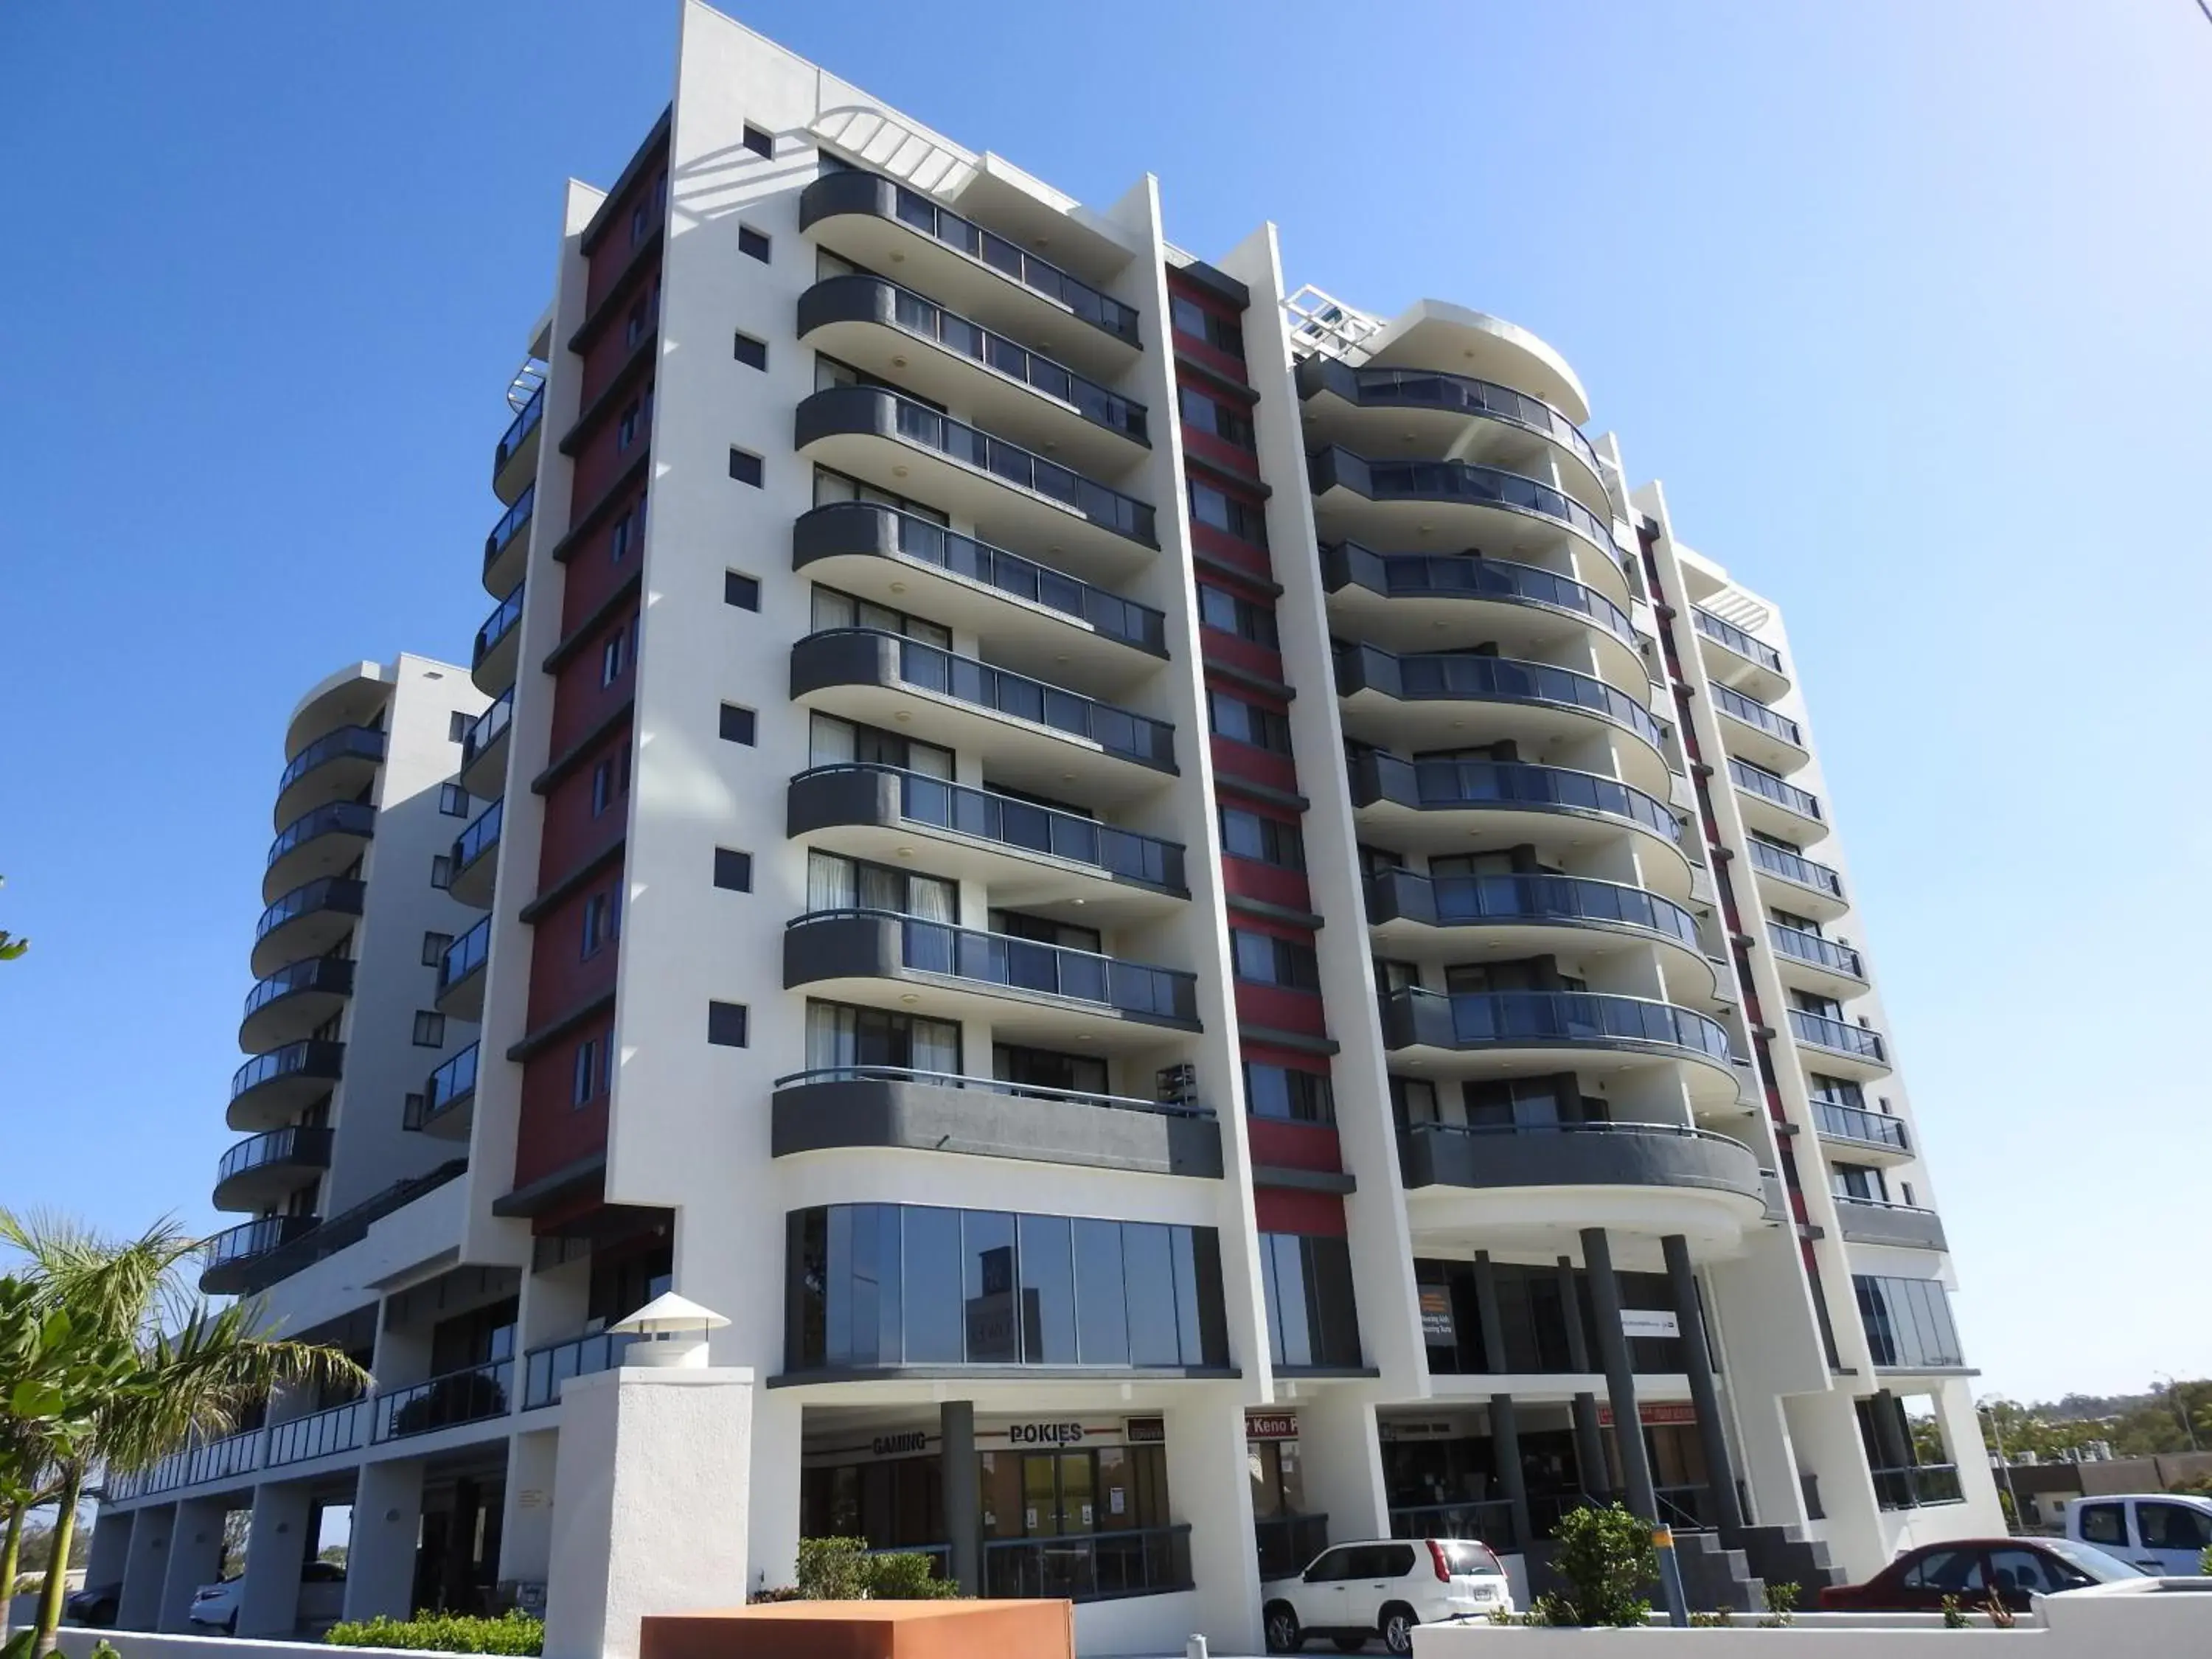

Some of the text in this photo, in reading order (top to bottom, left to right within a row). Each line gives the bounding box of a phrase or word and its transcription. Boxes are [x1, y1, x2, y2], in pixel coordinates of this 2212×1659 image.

[1010, 1422, 1082, 1443] POKIES
[1253, 1418, 1287, 1433] Keno
[873, 1431, 925, 1455] GAMING
